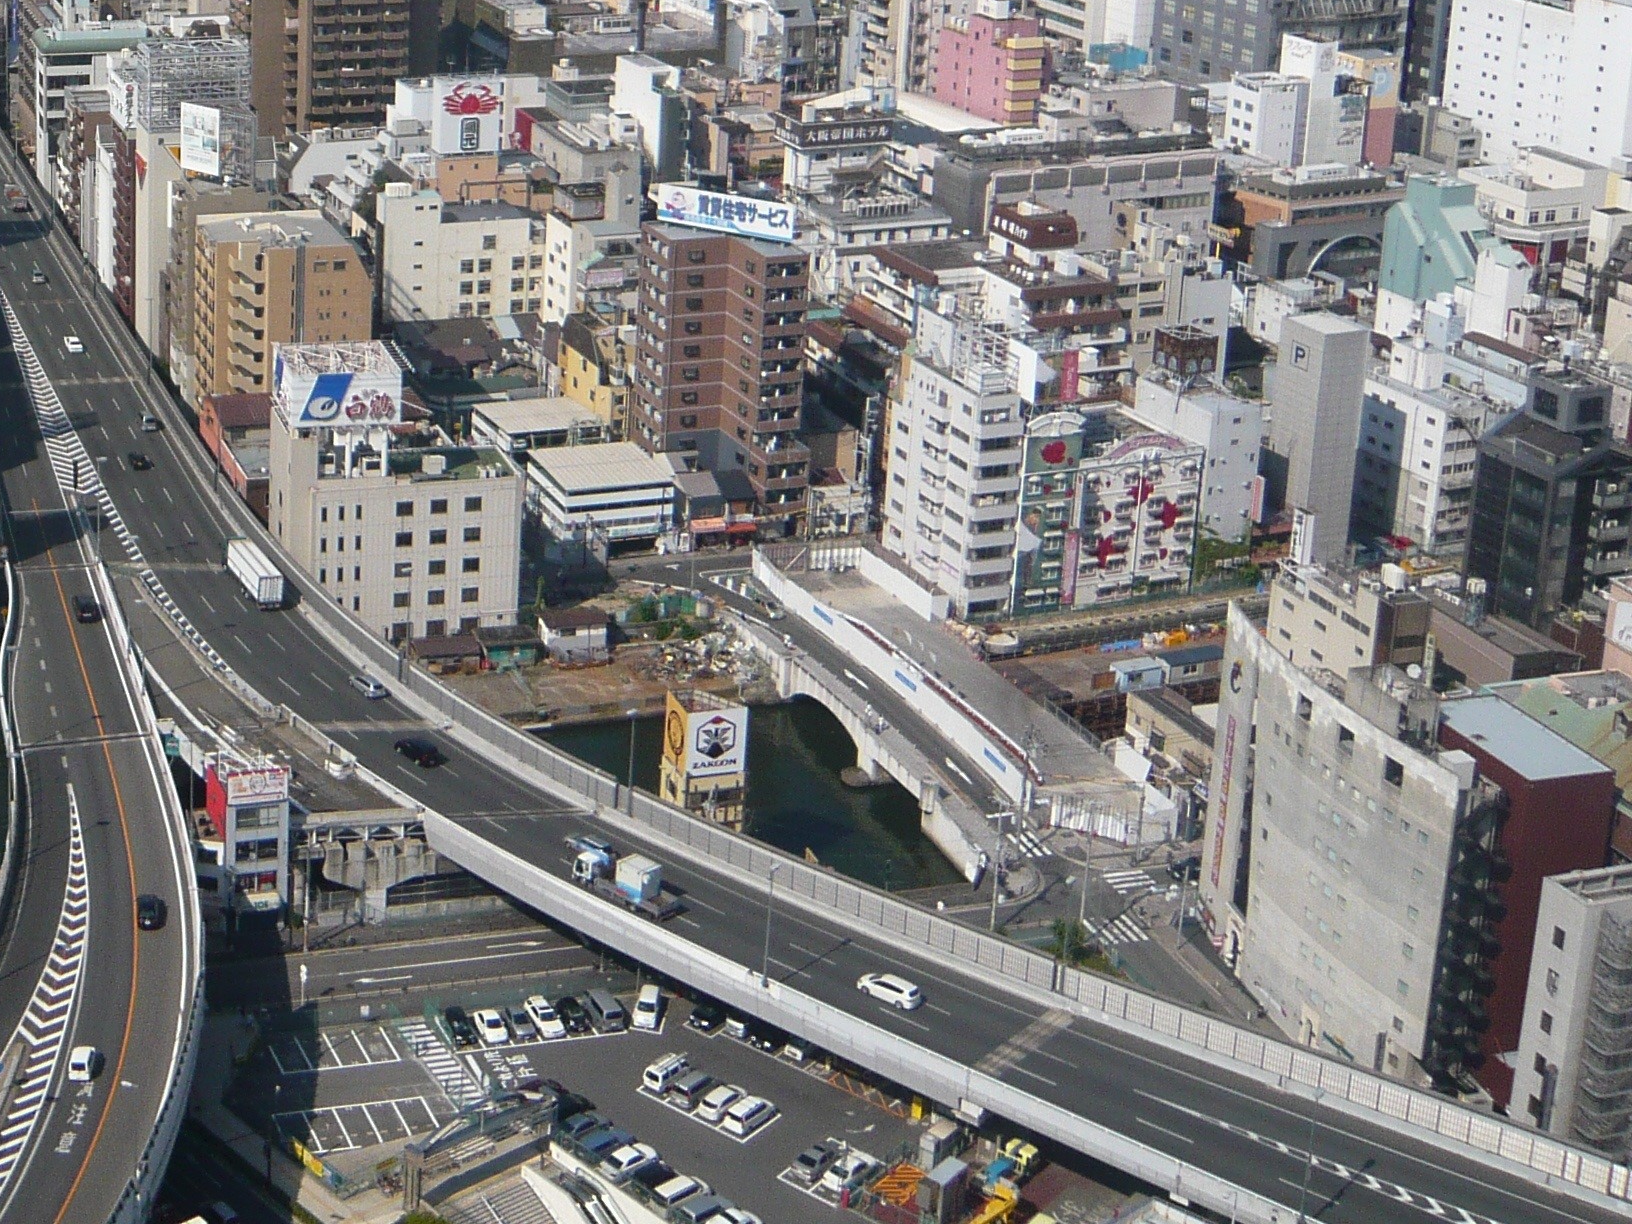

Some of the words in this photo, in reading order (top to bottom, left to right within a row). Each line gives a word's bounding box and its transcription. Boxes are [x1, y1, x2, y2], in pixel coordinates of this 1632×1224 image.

[805, 126, 889, 142] 大阪帝国ホテル
[697, 194, 790, 229] 賃貸住宅サービス
[1294, 347, 1306, 365] P
